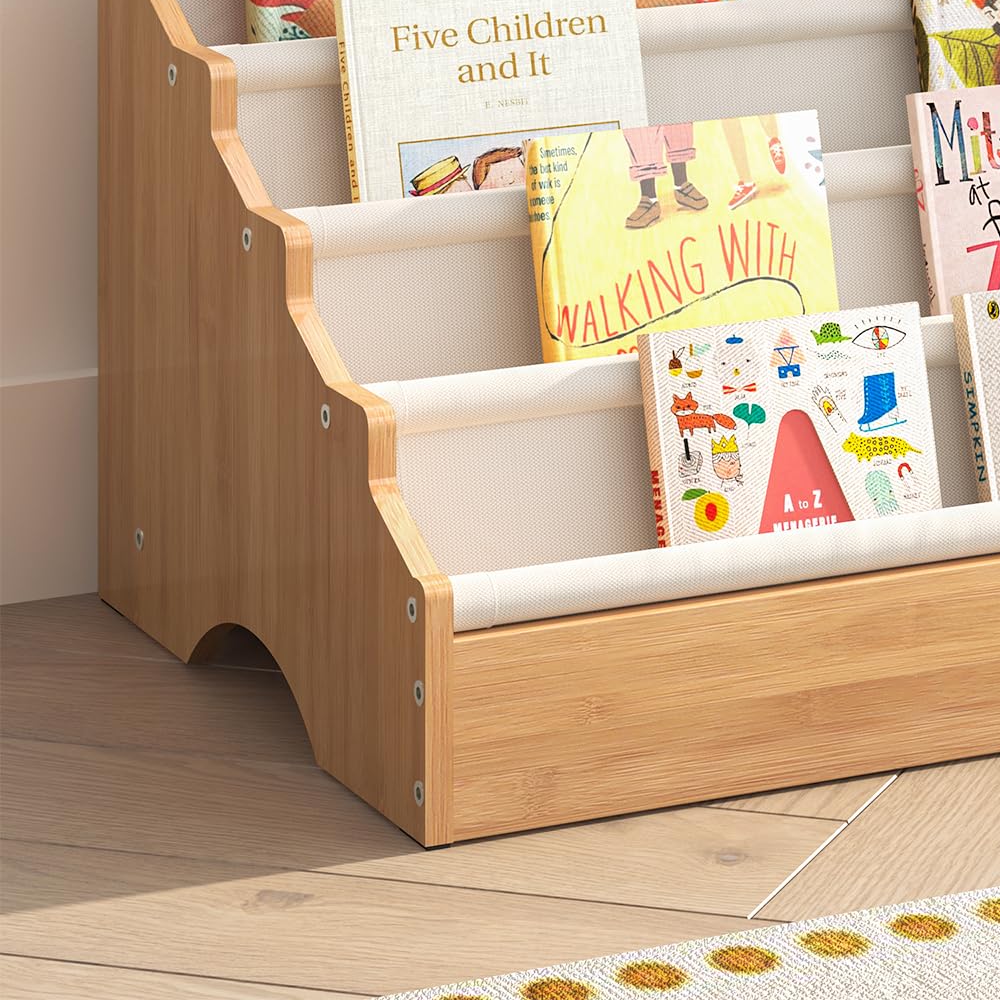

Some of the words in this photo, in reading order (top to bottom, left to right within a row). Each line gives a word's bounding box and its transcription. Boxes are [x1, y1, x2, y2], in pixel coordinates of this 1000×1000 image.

[390, 24, 459, 53] Five
[467, 12, 608, 46] Children
[338, 42, 347, 74] Five
[458, 53, 519, 84] and
[529, 51, 553, 77] It
[342, 82, 354, 152] Children
[349, 160, 360, 189] and
[968, 177, 992, 207] at
[557, 236, 706, 344] WALKING
[718, 219, 797, 282] WITH
[963, 372, 987, 483] SIMPKIN
[651, 470, 666, 548] MENAGE
[783, 493, 795, 513] A
[798, 500, 809, 509] to
[812, 489, 823, 509] Z
